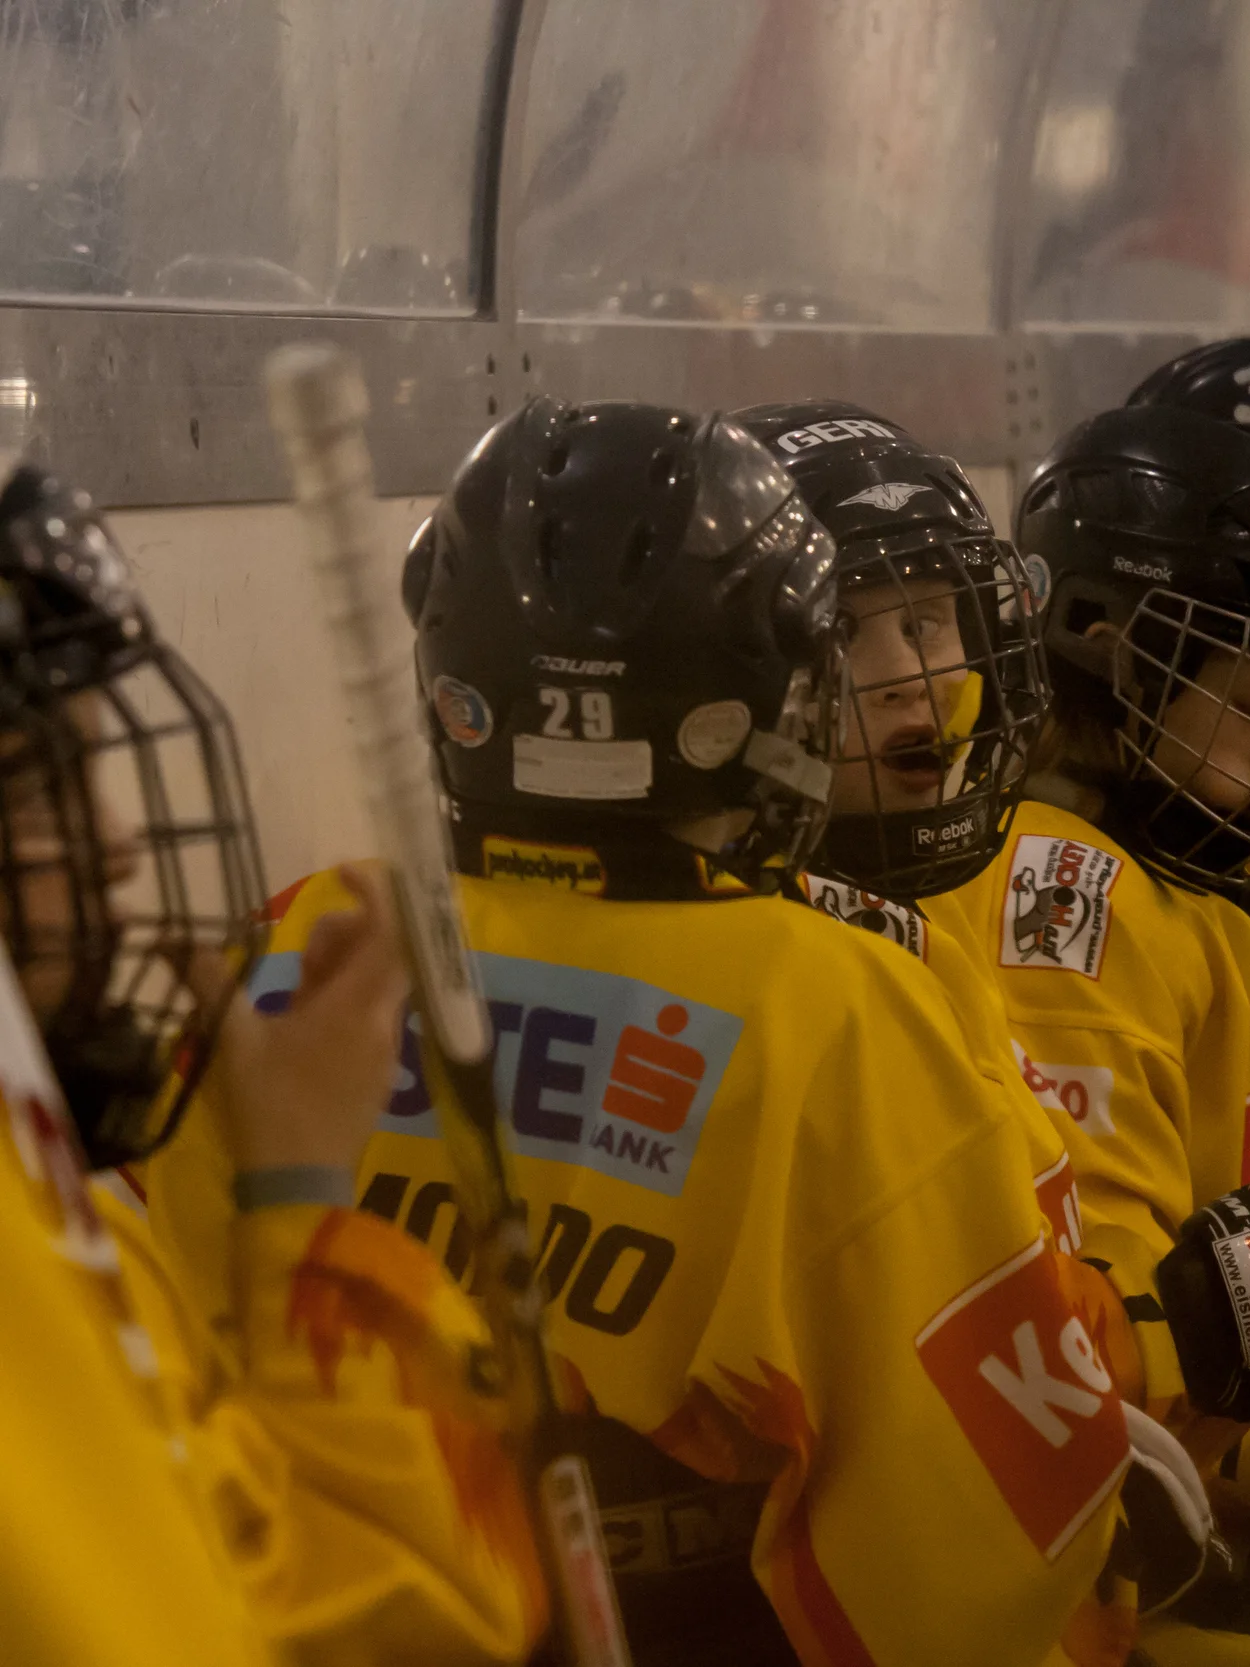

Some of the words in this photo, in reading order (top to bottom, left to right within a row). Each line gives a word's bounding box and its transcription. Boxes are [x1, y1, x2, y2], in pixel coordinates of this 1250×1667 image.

[777, 420, 897, 454] GERI
[539, 687, 615, 739] 29
[978, 1315, 1113, 1449] Ke
